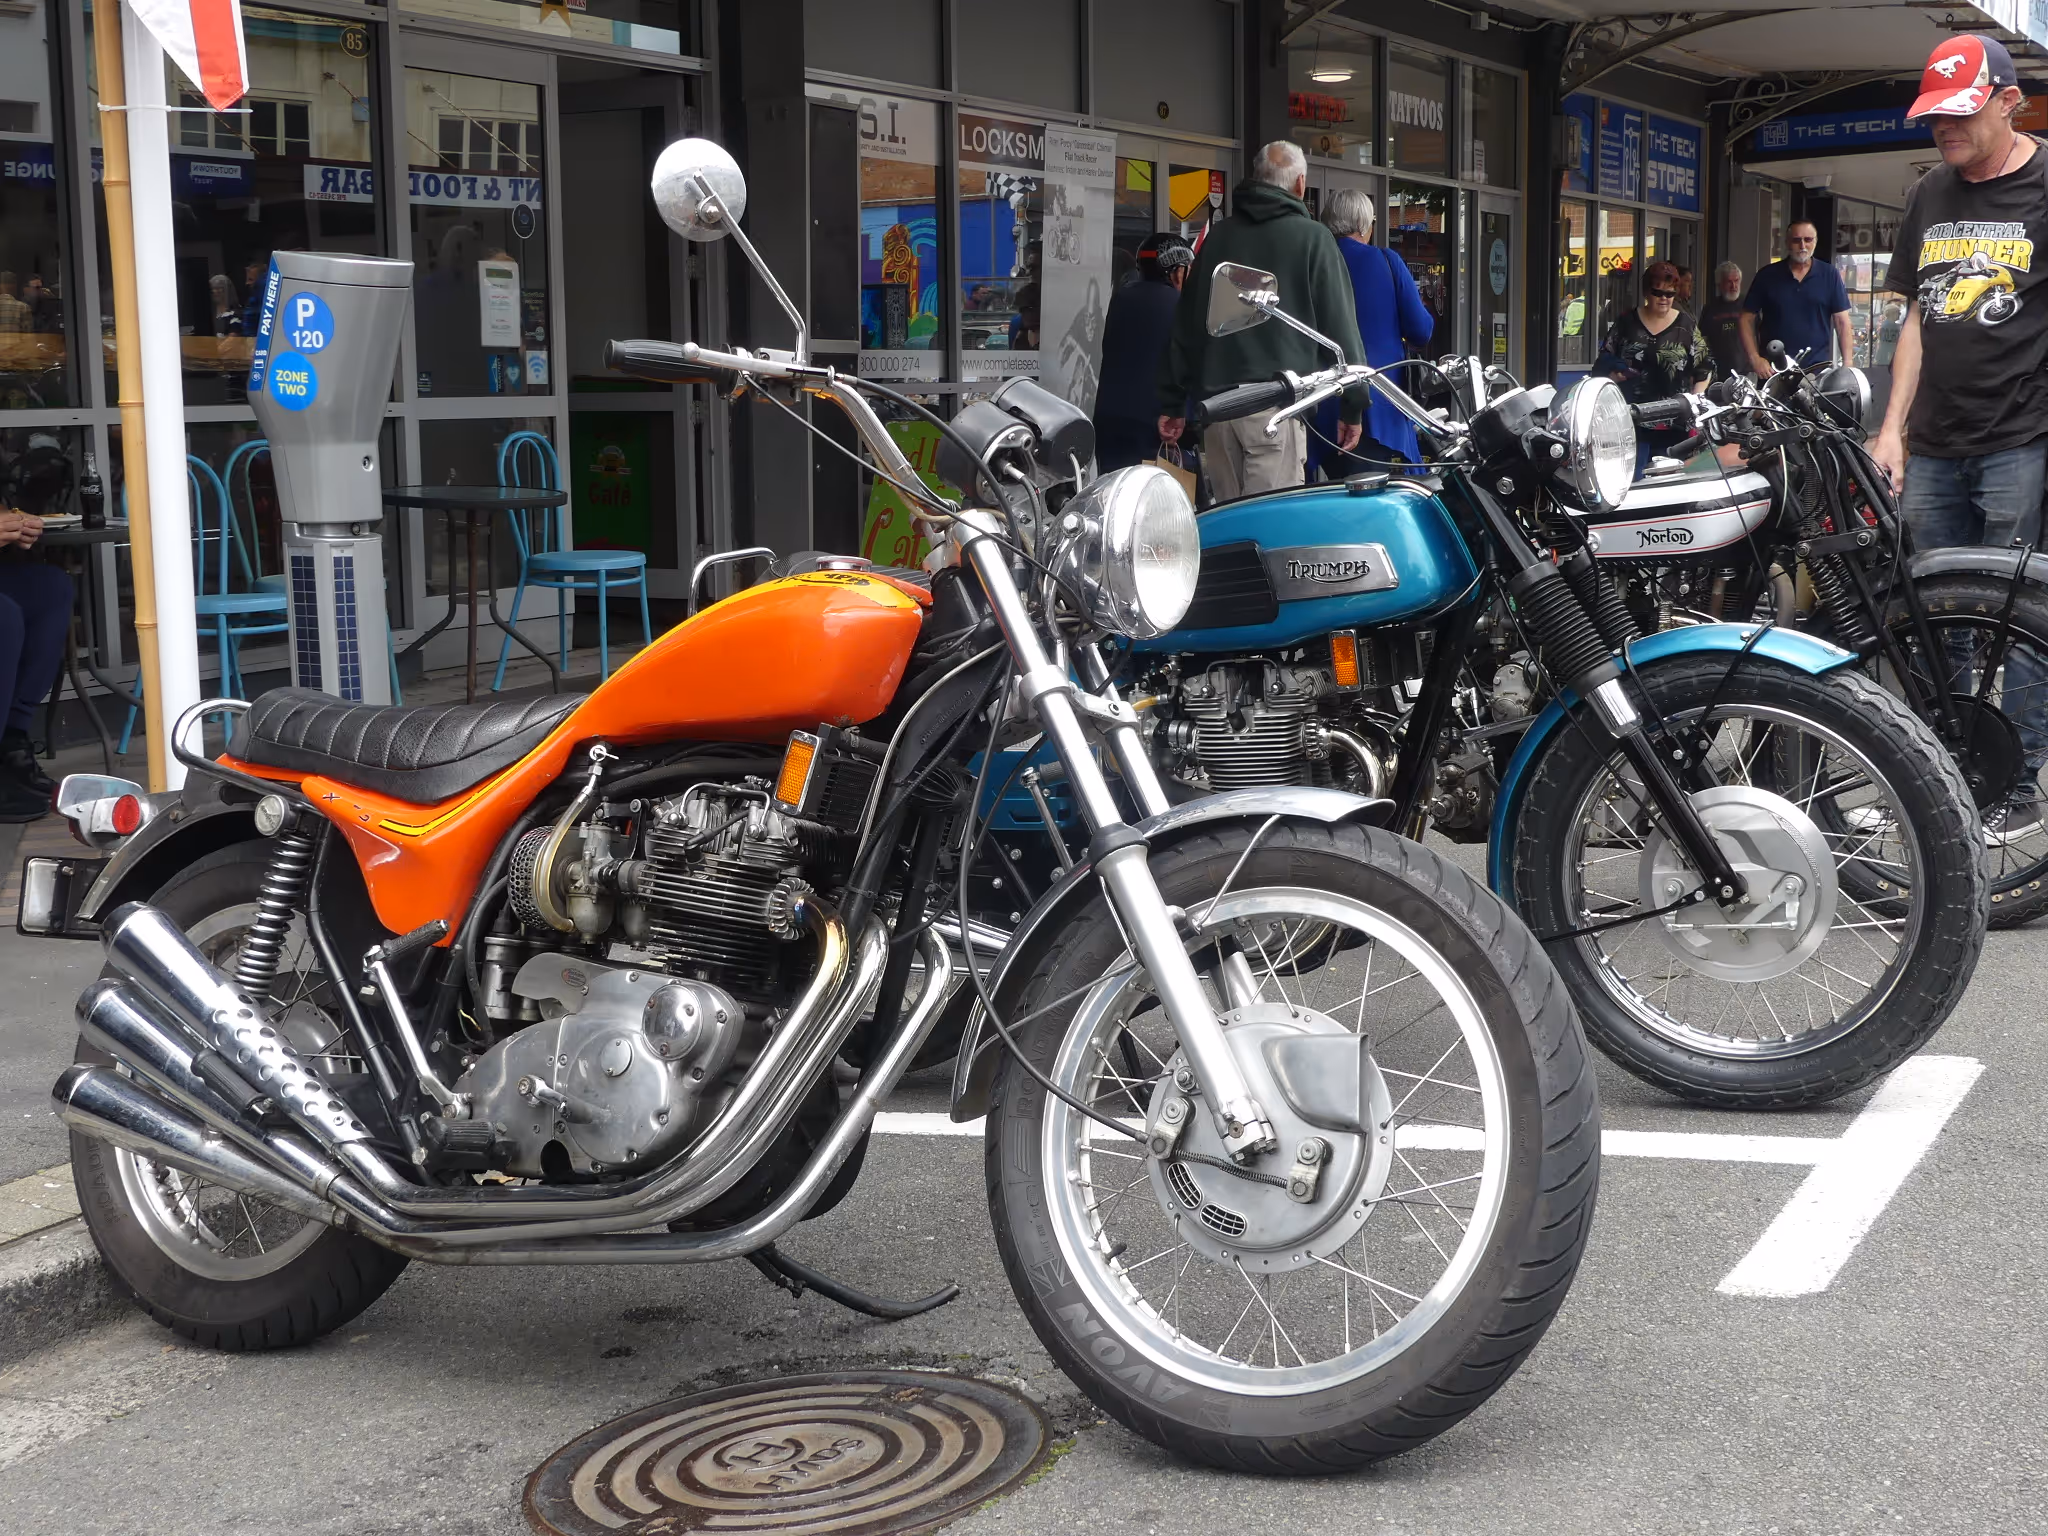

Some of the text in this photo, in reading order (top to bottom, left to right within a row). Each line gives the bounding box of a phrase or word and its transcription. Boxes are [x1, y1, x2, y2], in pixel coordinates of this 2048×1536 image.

[346, 32, 363, 51] 85
[1389, 90, 1443, 131] TATTOOS
[1794, 125, 1836, 138] THE
[1842, 119, 1896, 133] TECH
[961, 124, 1044, 161] LOCKSM
[1648, 130, 1696, 160] THE TECH
[1647, 160, 1695, 197] STORE
[1923, 221, 2026, 240] 2018 CENTRAL
[1918, 238, 2034, 273] THUNDER
[260, 271, 280, 336] PAY HERE
[1949, 290, 1966, 300] 101
[297, 298, 315, 328] P
[293, 330, 324, 349] 120
[275, 369, 309, 384] ZONE
[880, 357, 899, 373] 000
[901, 357, 921, 374] 274
[278, 383, 307, 396] TWO
[1636, 527, 1694, 548] Norton
[1286, 560, 1371, 583] TRIUMPH
[1056, 1302, 1193, 1402] AVON
